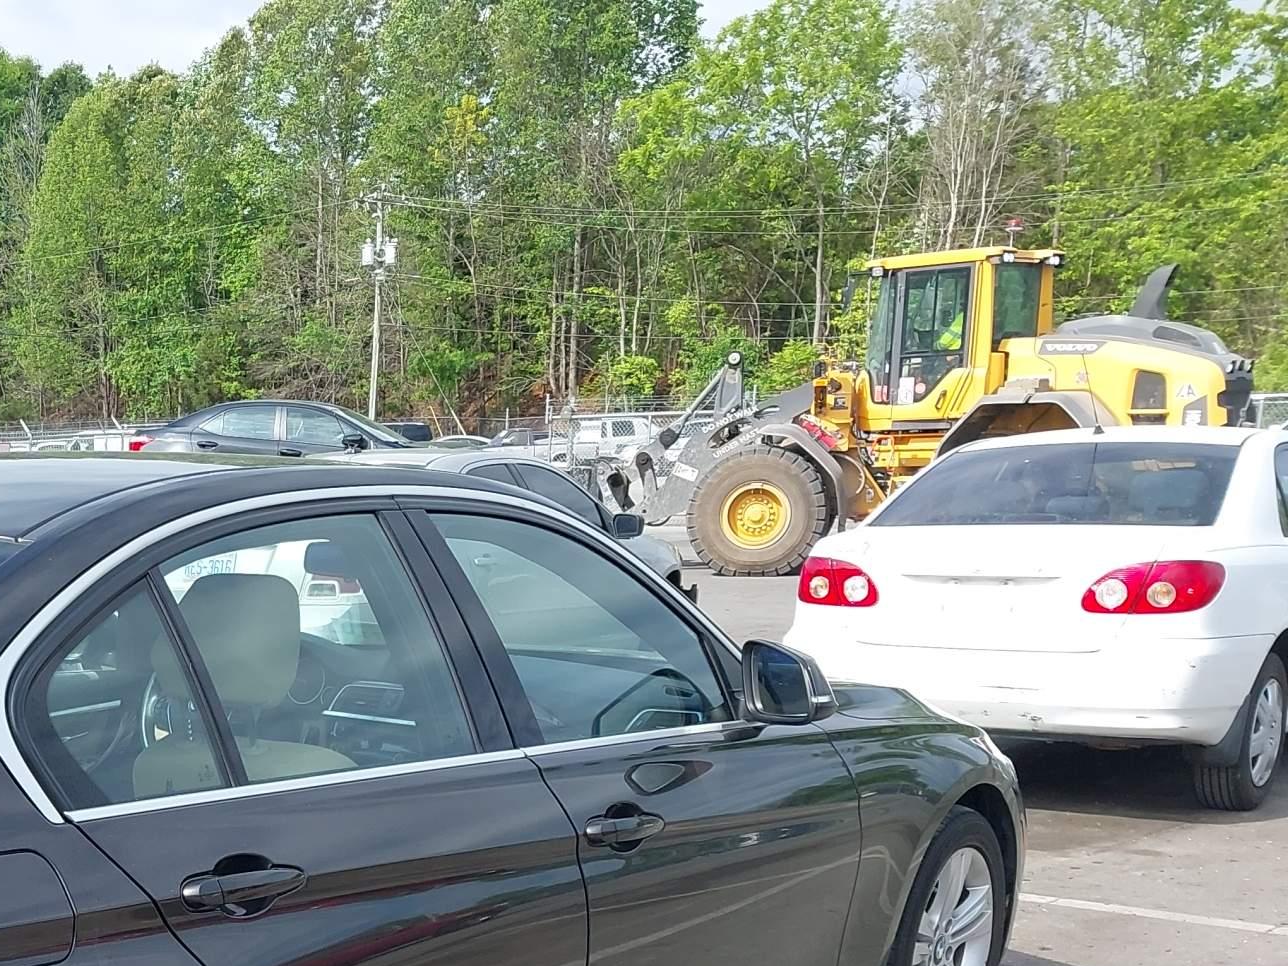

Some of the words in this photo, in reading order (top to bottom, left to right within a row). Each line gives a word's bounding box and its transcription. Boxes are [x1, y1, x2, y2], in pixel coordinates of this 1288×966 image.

[1045, 343, 1098, 353] VOLVO
[702, 423, 715, 434] DO
[715, 411, 734, 427] NOT
[733, 404, 760, 419] WALK
[712, 440, 738, 458] UNDER
